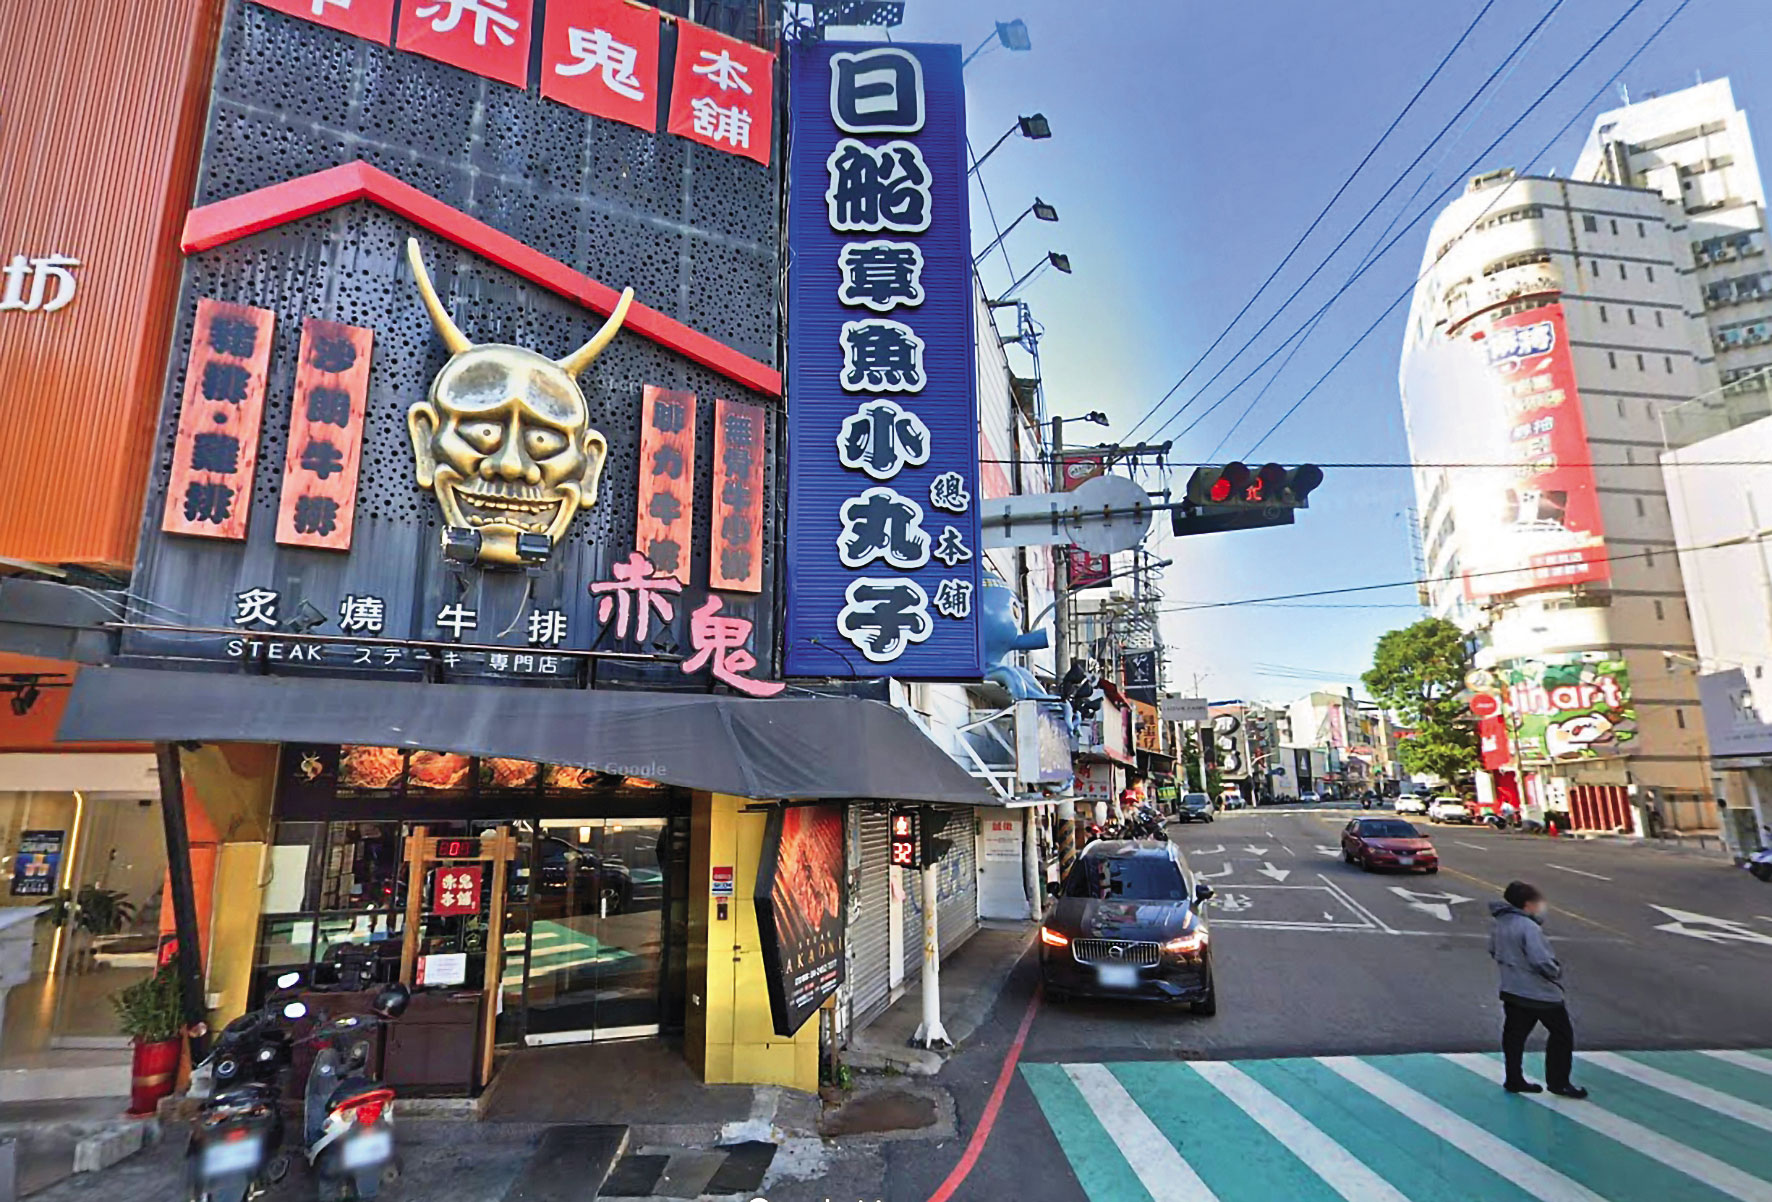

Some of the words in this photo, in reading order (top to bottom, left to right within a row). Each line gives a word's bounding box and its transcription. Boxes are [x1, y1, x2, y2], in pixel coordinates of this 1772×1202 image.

[692, 49, 753, 149] 本舖
[0, 253, 82, 312] 坊
[825, 47, 933, 662] 日船章魚小丸子
[930, 471, 973, 619] 總本舖
[226, 640, 322, 661] STEAK
[352, 647, 461, 669] ステーキ
[236, 586, 569, 646] 炙燒牛排
[588, 551, 787, 699] 赤鬼
[893, 842, 912, 863] 32
